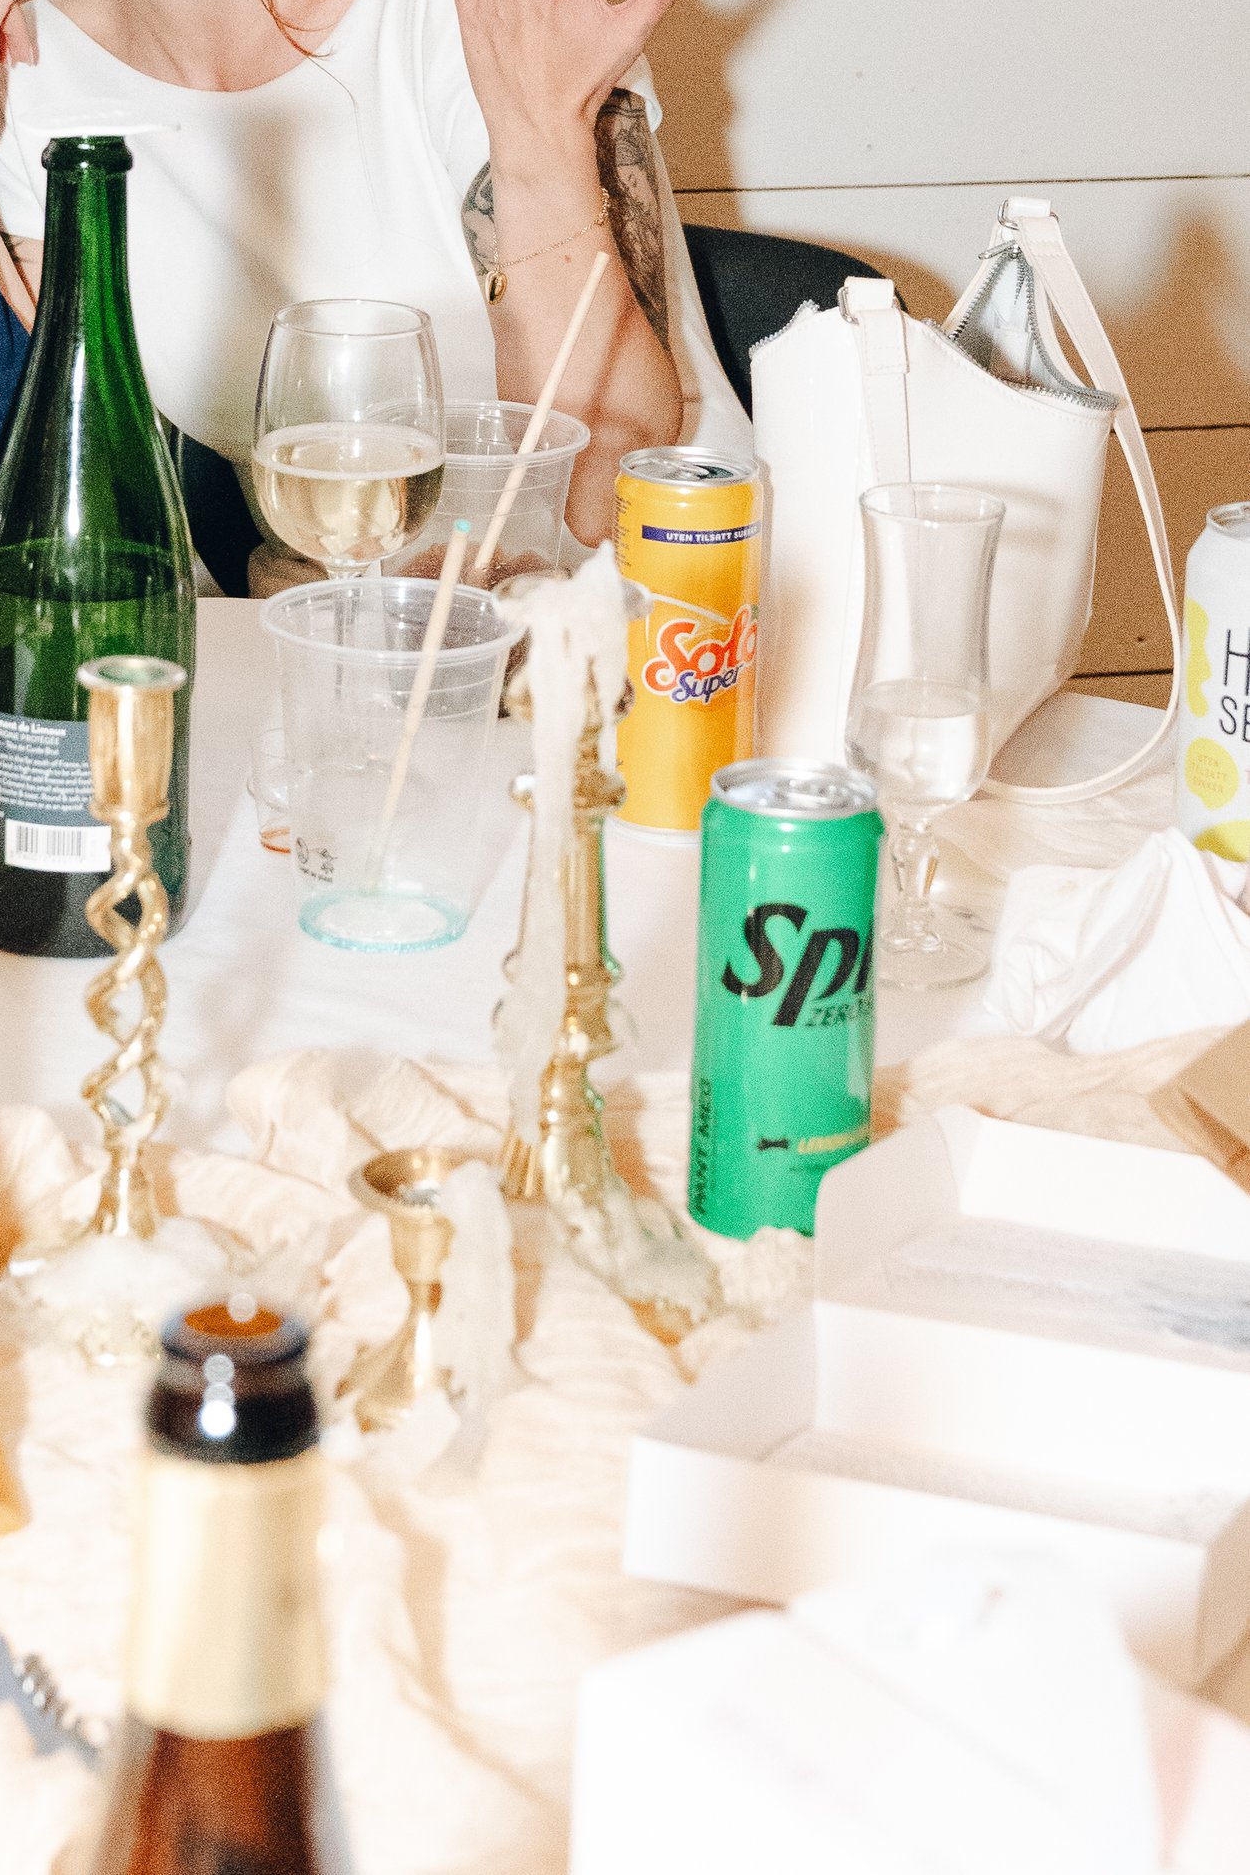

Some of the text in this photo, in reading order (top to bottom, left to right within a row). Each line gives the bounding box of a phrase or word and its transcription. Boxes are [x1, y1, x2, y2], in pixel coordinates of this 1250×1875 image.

[665, 532, 693, 542] UTEN
[695, 531, 732, 542] TILSATT
[671, 662, 744, 705] Super
[694, 1148, 708, 1215] PANT
